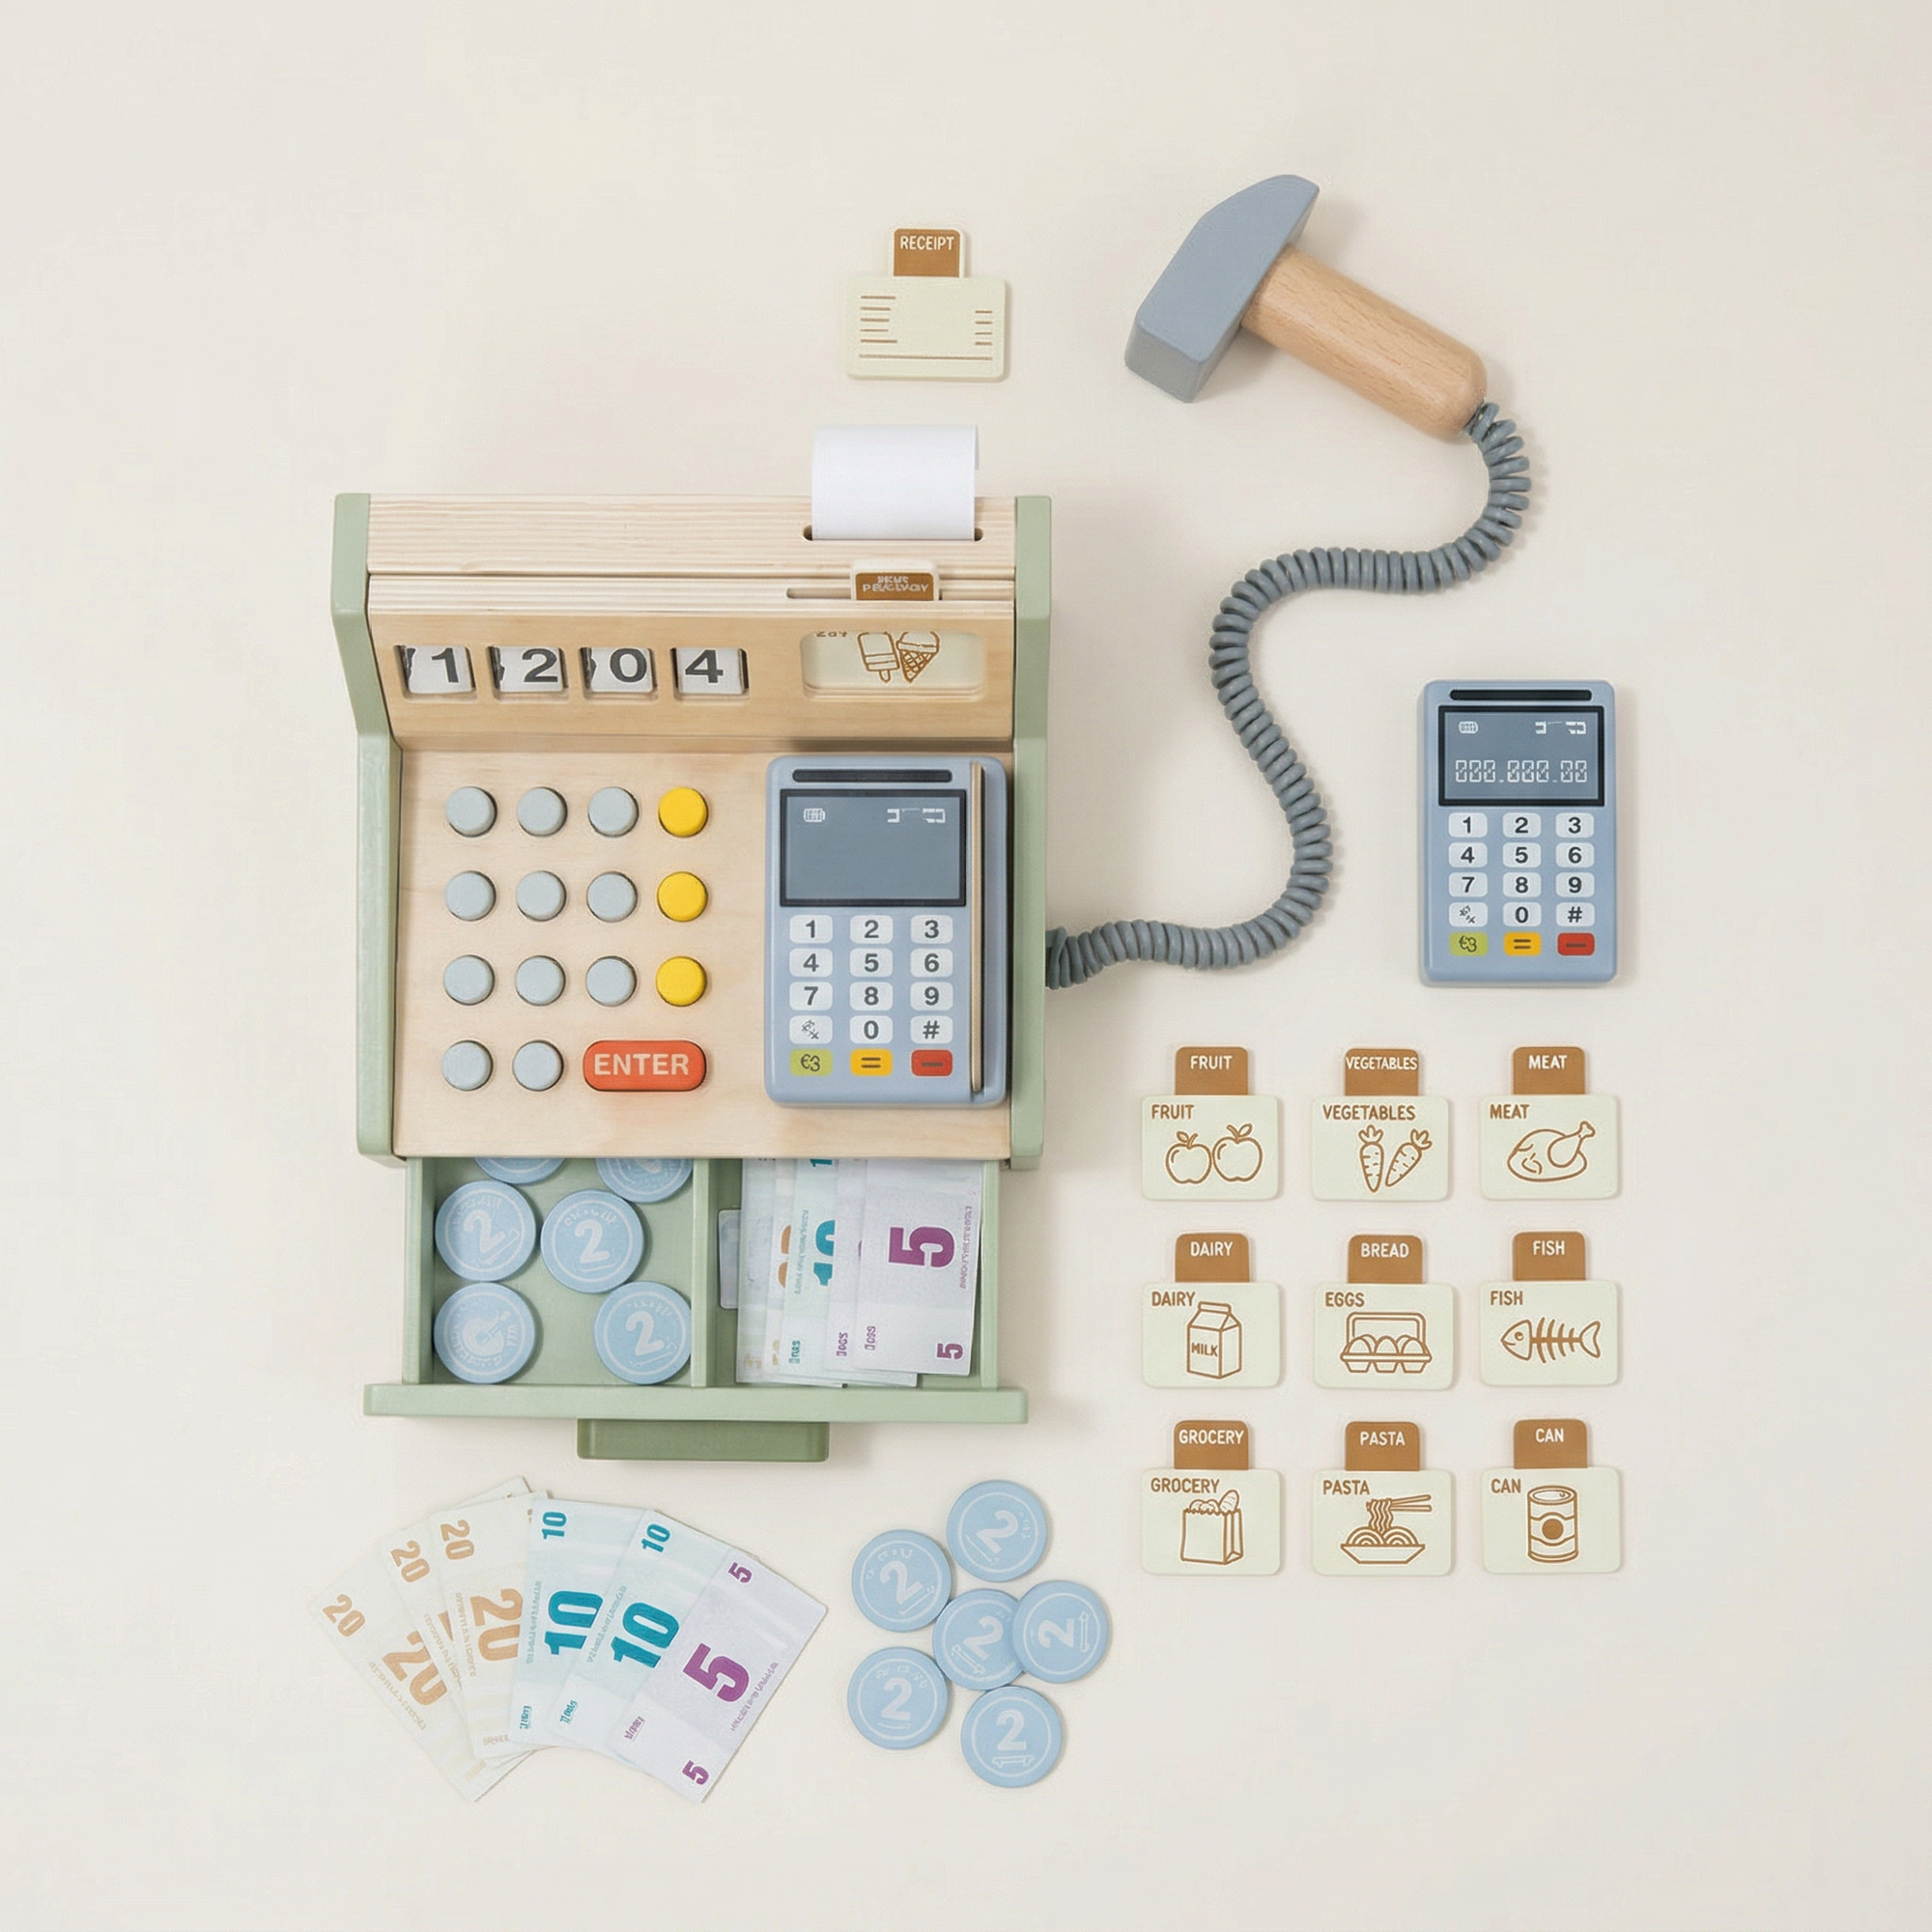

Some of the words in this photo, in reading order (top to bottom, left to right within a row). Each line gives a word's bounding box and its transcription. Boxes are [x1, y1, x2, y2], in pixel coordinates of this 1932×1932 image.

[900, 236, 953, 250] RECEIPT
[432, 648, 458, 683] 1
[522, 648, 558, 682] 2
[611, 648, 647, 682] 0
[685, 650, 723, 683] 4
[1463, 816, 1471, 834] 1
[1515, 816, 1529, 834] 2
[1568, 816, 1581, 835] 3
[1460, 846, 1475, 864] 4
[1515, 846, 1529, 865] 5
[1568, 846, 1582, 865] 6
[1462, 876, 1475, 894] 7
[1515, 876, 1529, 894] 8
[1568, 876, 1582, 894] 9
[1515, 906, 1529, 923] 0
[806, 919, 815, 939] 1
[864, 919, 880, 939] 2
[923, 919, 940, 939] 3
[803, 952, 820, 973] 4
[864, 952, 879, 973] 5
[923, 952, 940, 973] 6
[804, 985, 819, 1007] 7
[864, 985, 879, 1007] 8
[923, 985, 940, 1007] 9
[864, 1019, 879, 1040] 0
[595, 1054, 688, 1075] ENTER
[1191, 1056, 1232, 1069] FRUIT
[1346, 1056, 1418, 1070] VEGETABLES
[1529, 1055, 1567, 1068] MEAT
[1152, 1104, 1194, 1120] FRUIT
[1323, 1105, 1415, 1121] VEGETABLES
[1491, 1104, 1529, 1119] MEAT
[464, 1209, 506, 1253] 2
[575, 1219, 611, 1264] 2
[889, 1227, 954, 1267] 5
[1191, 1241, 1233, 1256] DAIRY
[1361, 1243, 1408, 1258] BREAD
[1533, 1240, 1564, 1255] FISH
[1152, 1292, 1195, 1306] DAIRY
[1325, 1293, 1364, 1307] EGGS
[1491, 1291, 1522, 1305] FISH
[626, 1311, 665, 1356] 2
[937, 1344, 963, 1359] 5
[1192, 1343, 1217, 1356] MILK
[1179, 1430, 1243, 1444] GROCERY
[1360, 1432, 1405, 1445] PASTA
[1536, 1429, 1563, 1442] CAN
[1151, 1478, 1219, 1493] GROCERY
[1323, 1480, 1370, 1494] PASTA
[1492, 1479, 1520, 1493] CAN
[542, 1512, 566, 1539] 10
[976, 1509, 1019, 1554] 2
[440, 1520, 474, 1559] 20
[641, 1524, 670, 1552] 10
[390, 1541, 430, 1582] 20
[728, 1562, 752, 1582] 5
[879, 1560, 923, 1605] 2
[323, 1595, 365, 1636] 20
[545, 1591, 603, 1655] 10
[611, 1603, 679, 1668] 10
[963, 1615, 1004, 1661] 2
[1037, 1618, 1074, 1648] 2
[683, 1643, 749, 1702] 5
[881, 1677, 912, 1721] 2
[996, 1709, 1027, 1750] 2
[682, 1760, 709, 1784] 5
